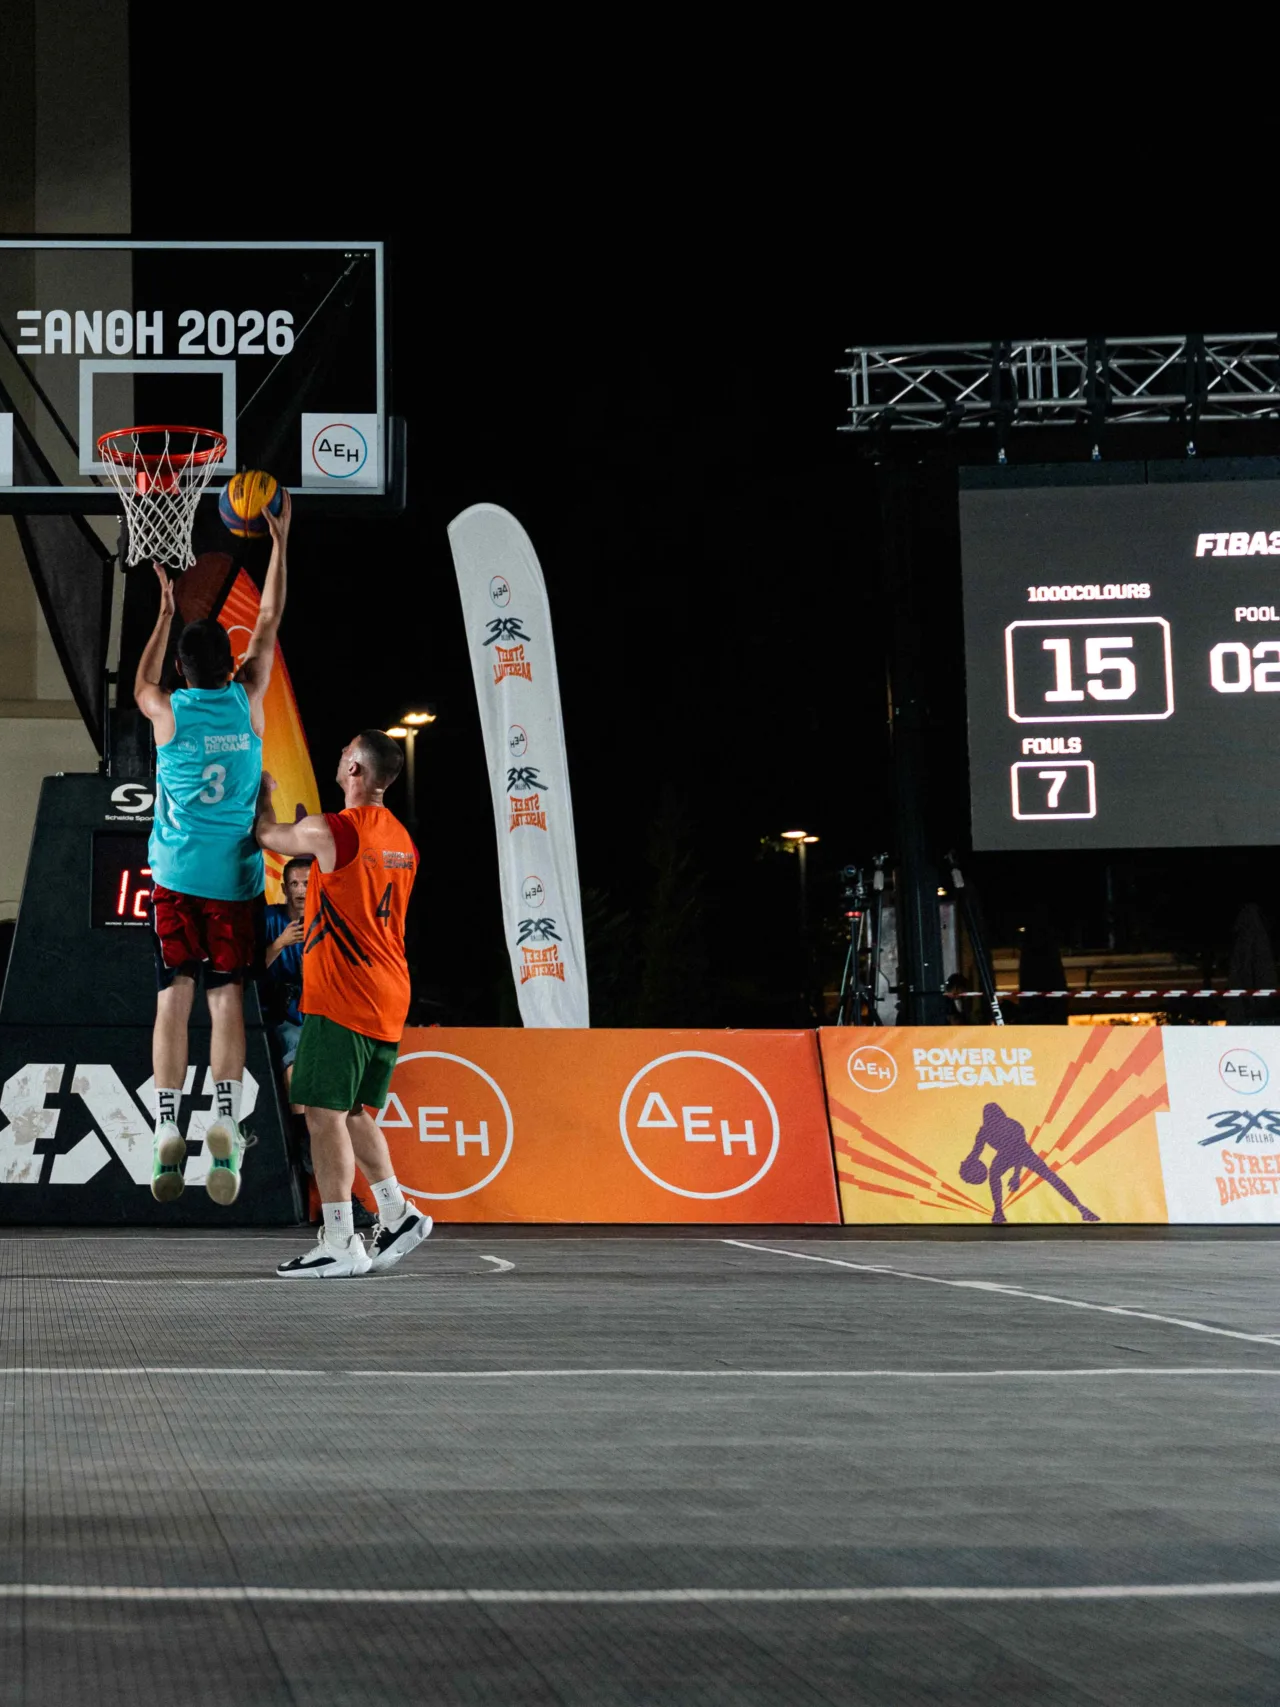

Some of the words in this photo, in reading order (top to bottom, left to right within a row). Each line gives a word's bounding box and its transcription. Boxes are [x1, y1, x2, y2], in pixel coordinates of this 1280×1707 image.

[17, 310, 163, 354] ΞΑΝΘΗ
[178, 309, 294, 355] 2026
[318, 438, 359, 462] ΔΕΗ
[1027, 583, 1151, 602] 1000COLOURS
[1042, 636, 1137, 702] 15
[204, 735, 237, 745] POWER
[239, 733, 250, 741] UP
[222, 741, 250, 752] GAME
[1022, 737, 1082, 755] FOULS
[200, 764, 227, 804] 3
[1038, 770, 1067, 808] 7
[375, 882, 392, 927] 4
[913, 1048, 997, 1066] POWER
[1000, 1048, 1032, 1066] UP
[853, 1058, 891, 1080] ΔΕΗ
[915, 1066, 955, 1081] THE
[956, 1066, 1036, 1086] GAME
[1224, 1061, 1262, 1081] ΔΕΗ
[637, 1092, 757, 1156] ΔΕΗ
